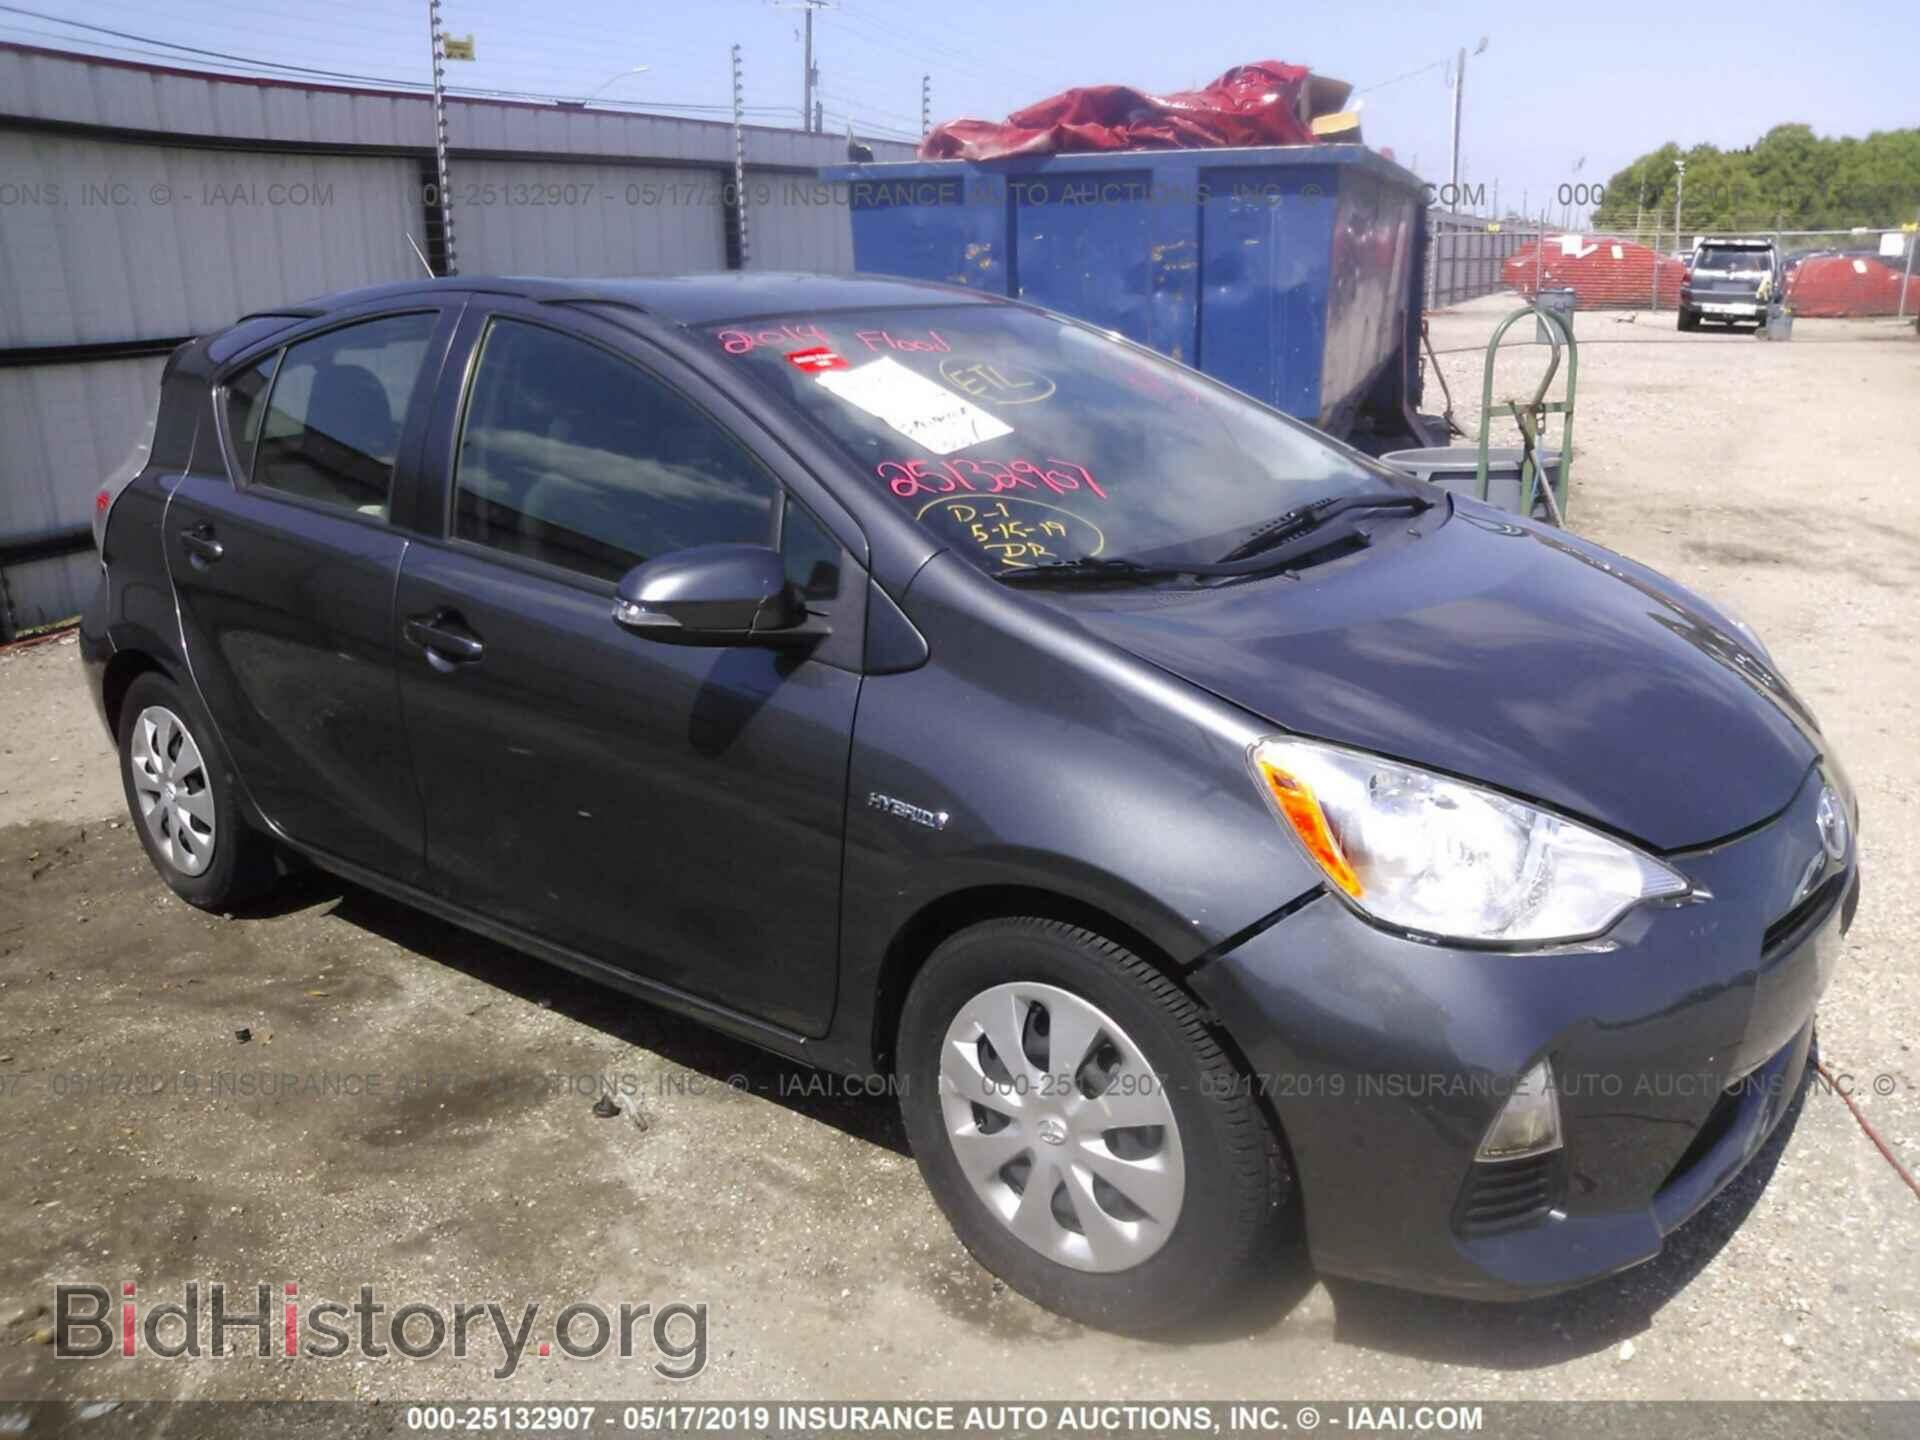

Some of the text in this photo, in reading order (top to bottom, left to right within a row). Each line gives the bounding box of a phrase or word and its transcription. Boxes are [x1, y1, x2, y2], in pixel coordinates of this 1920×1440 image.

[718, 324, 830, 355] 2014
[877, 458, 1107, 499] 25132907
[867, 792, 935, 828] HYBRID
